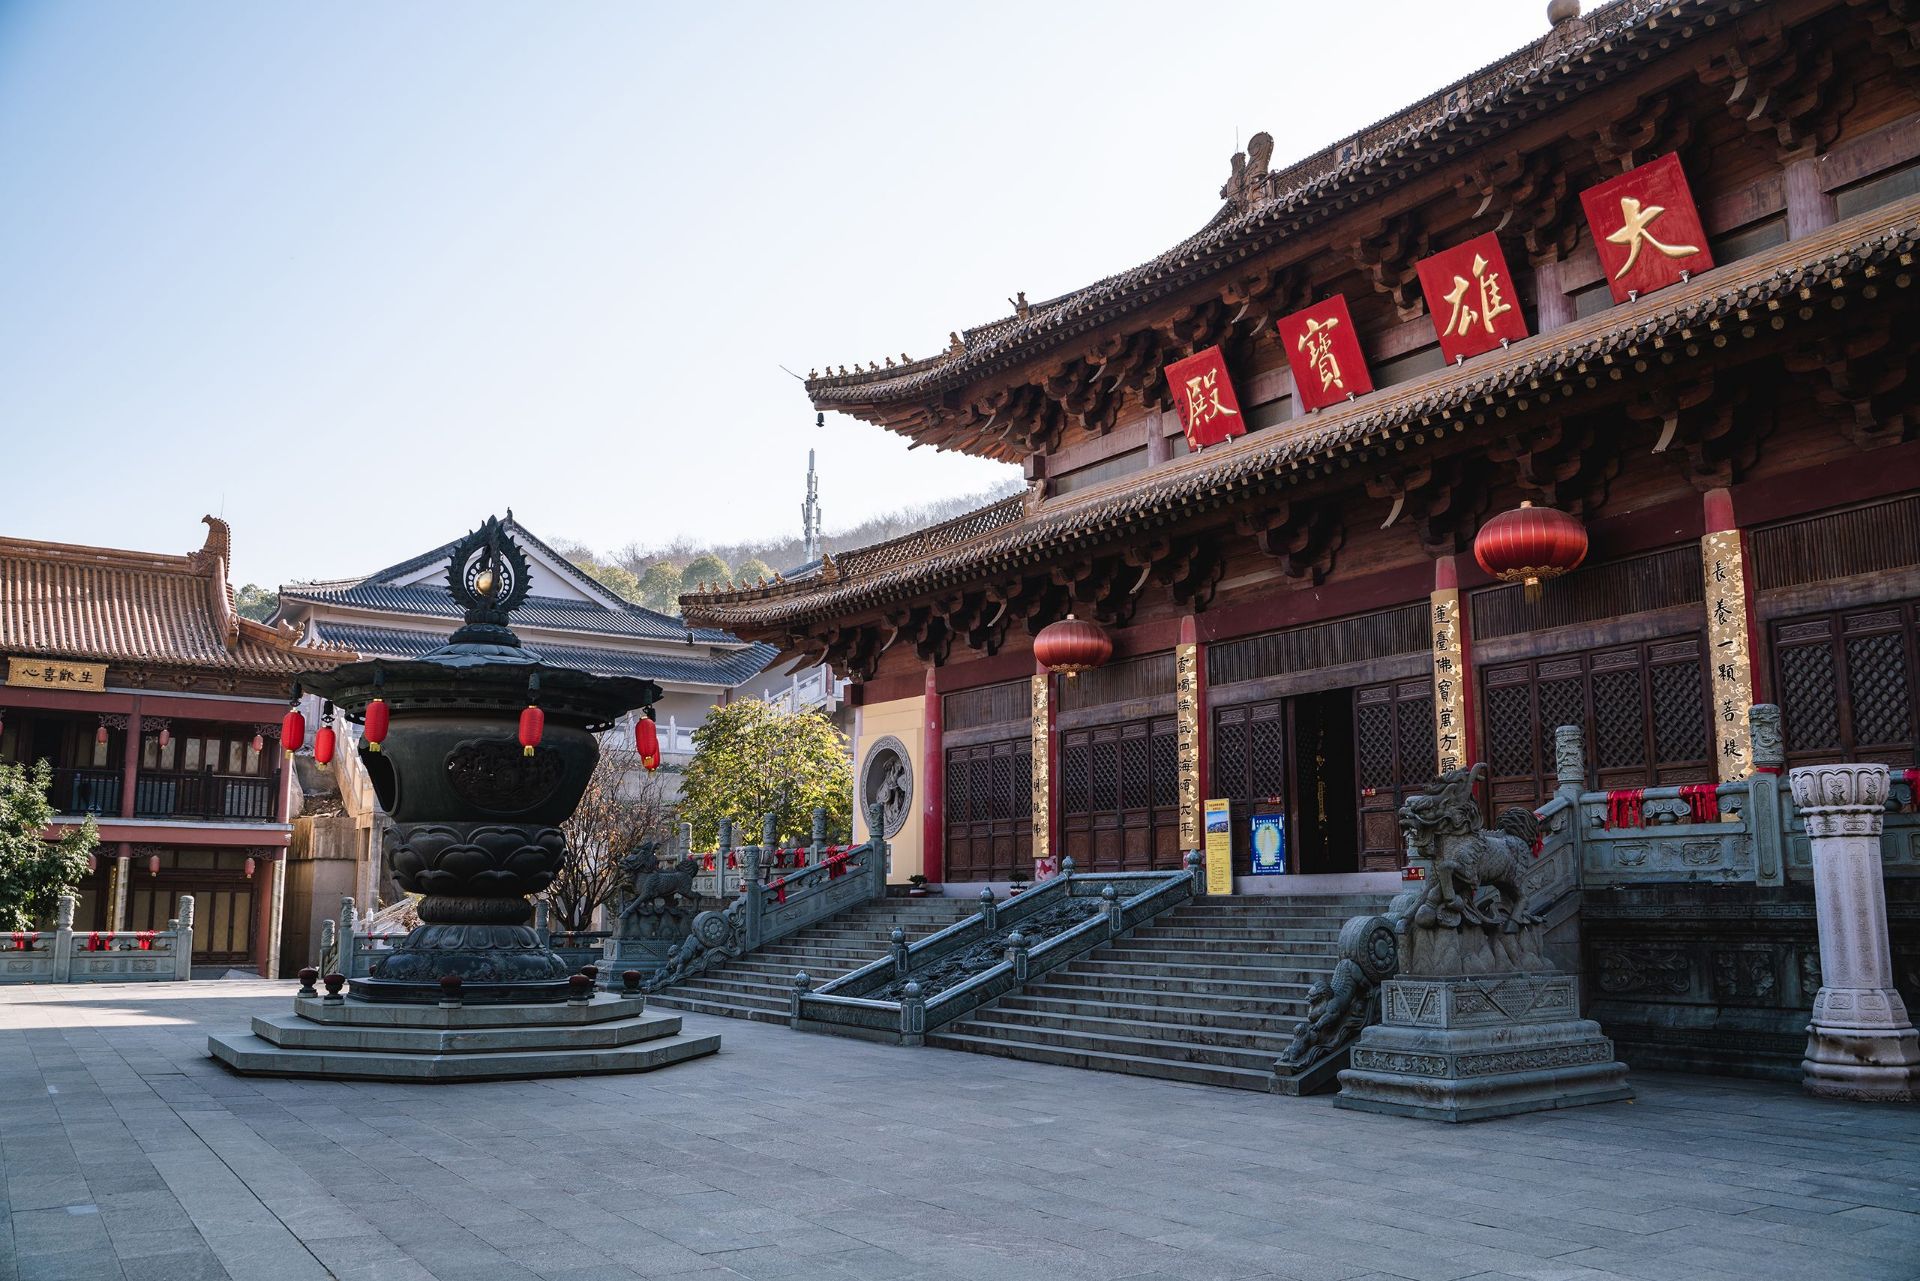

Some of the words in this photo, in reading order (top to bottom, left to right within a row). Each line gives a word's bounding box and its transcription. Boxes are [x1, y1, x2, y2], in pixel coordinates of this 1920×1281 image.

[1606, 197, 1700, 281] 大
[1443, 253, 1511, 337] 雄
[1298, 317, 1344, 393] 寶
[1185, 368, 1238, 438] 殿
[1712, 560, 1744, 783] 長養一顆菩提
